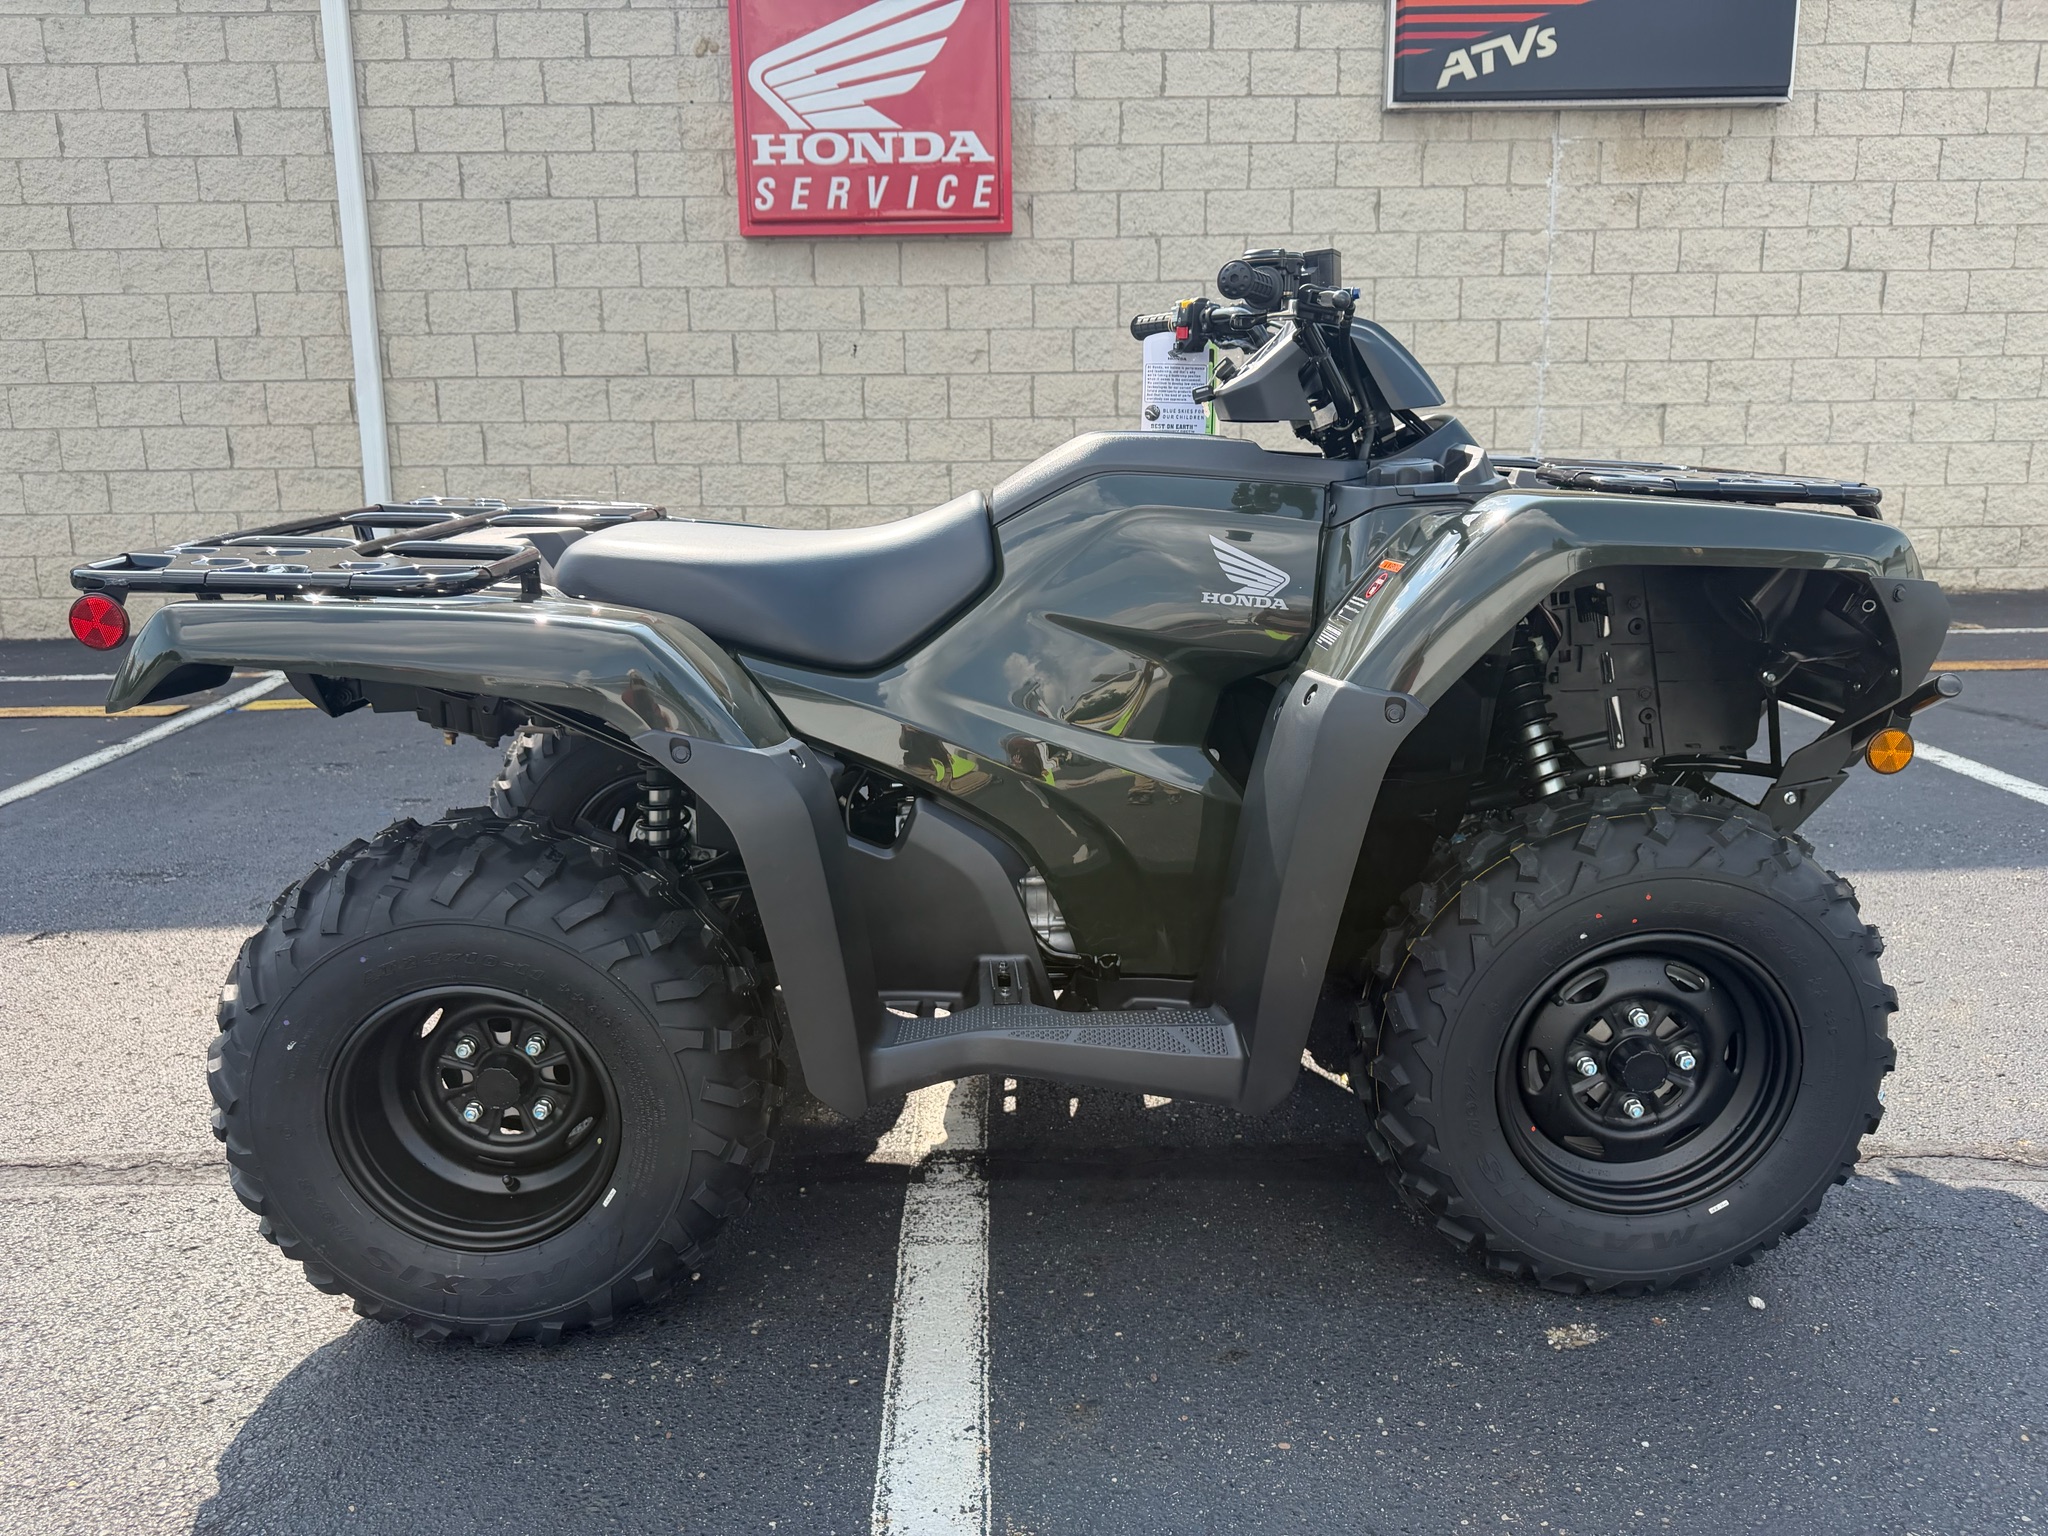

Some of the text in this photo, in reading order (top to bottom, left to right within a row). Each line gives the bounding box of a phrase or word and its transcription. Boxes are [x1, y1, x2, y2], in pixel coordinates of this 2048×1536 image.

[1436, 24, 1558, 91] ATVs
[751, 131, 995, 166] HONDA
[754, 174, 995, 211] SERVICE
[1201, 591, 1290, 611] HONDA
